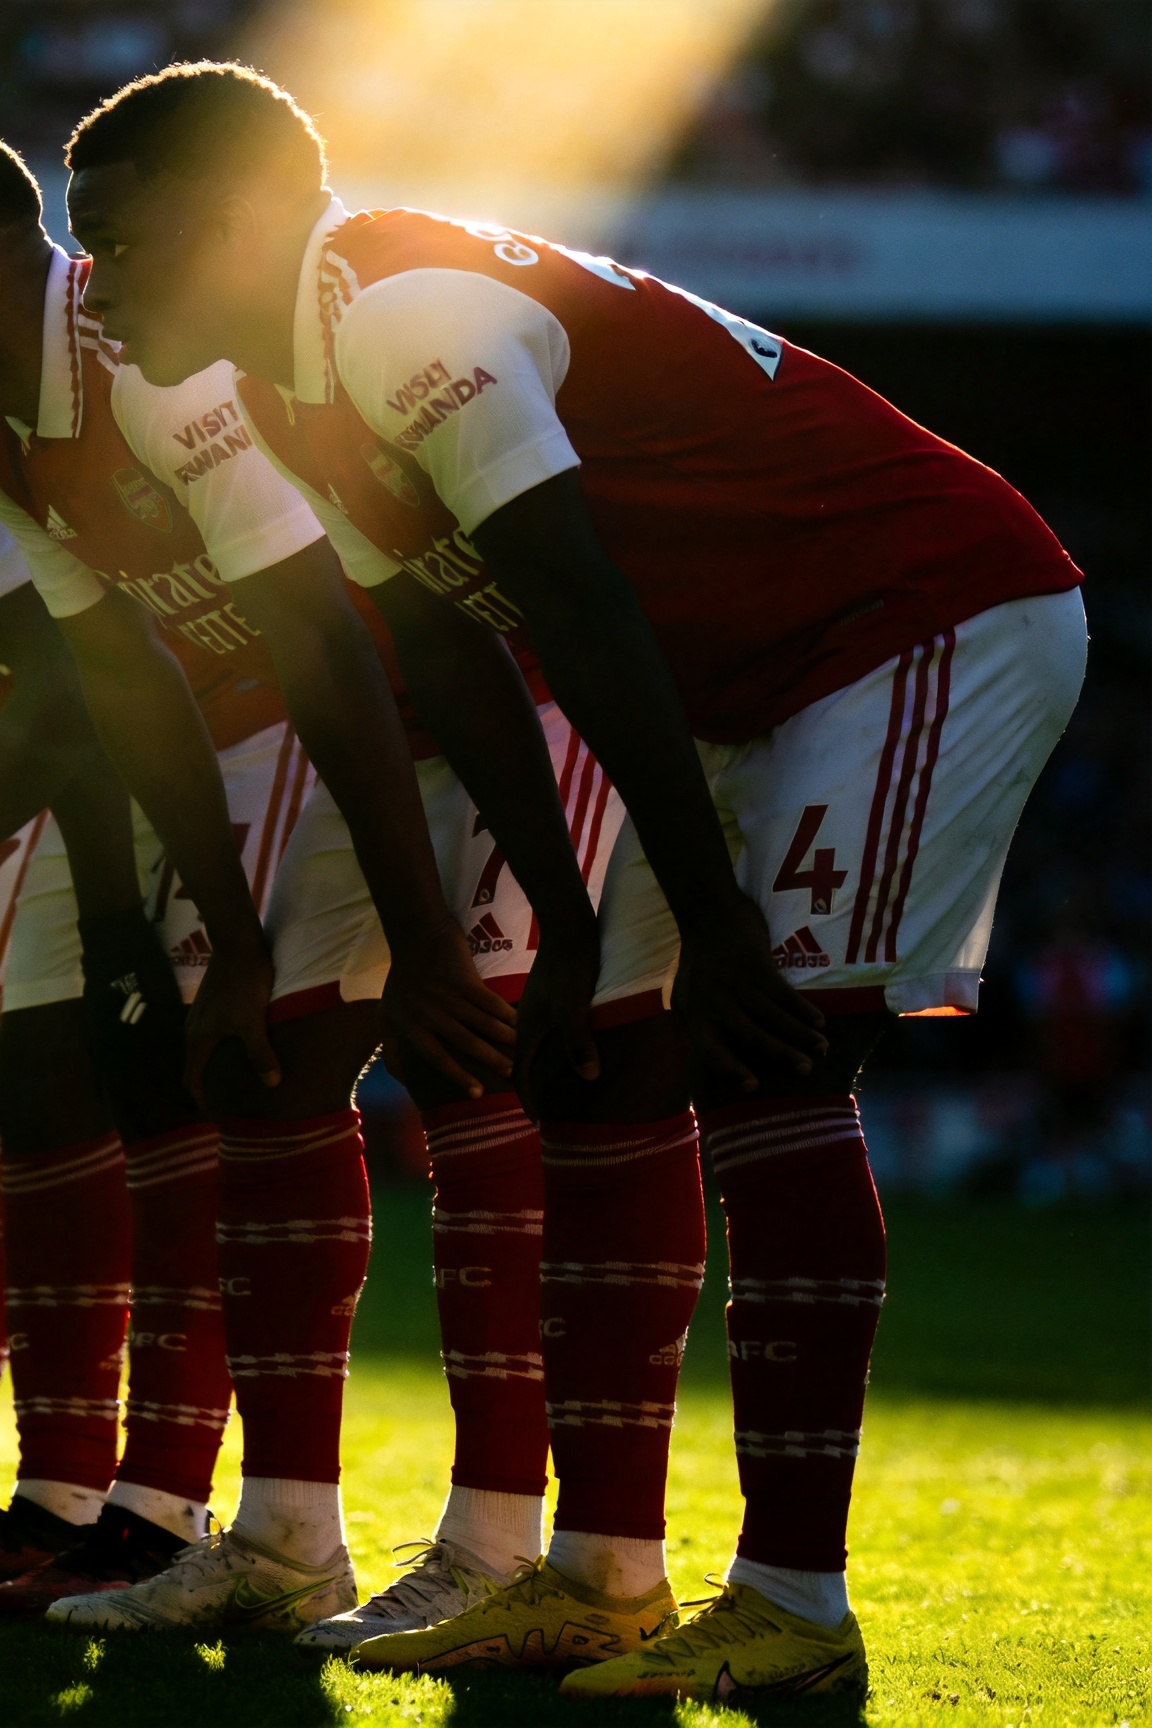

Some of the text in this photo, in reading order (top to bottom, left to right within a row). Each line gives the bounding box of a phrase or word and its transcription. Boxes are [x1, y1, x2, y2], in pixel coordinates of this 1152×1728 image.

[172, 401, 239, 450] VISIT
[174, 424, 253, 486] RWAN
[772, 805, 849, 915] 4
[435, 1266, 493, 1289] FC
